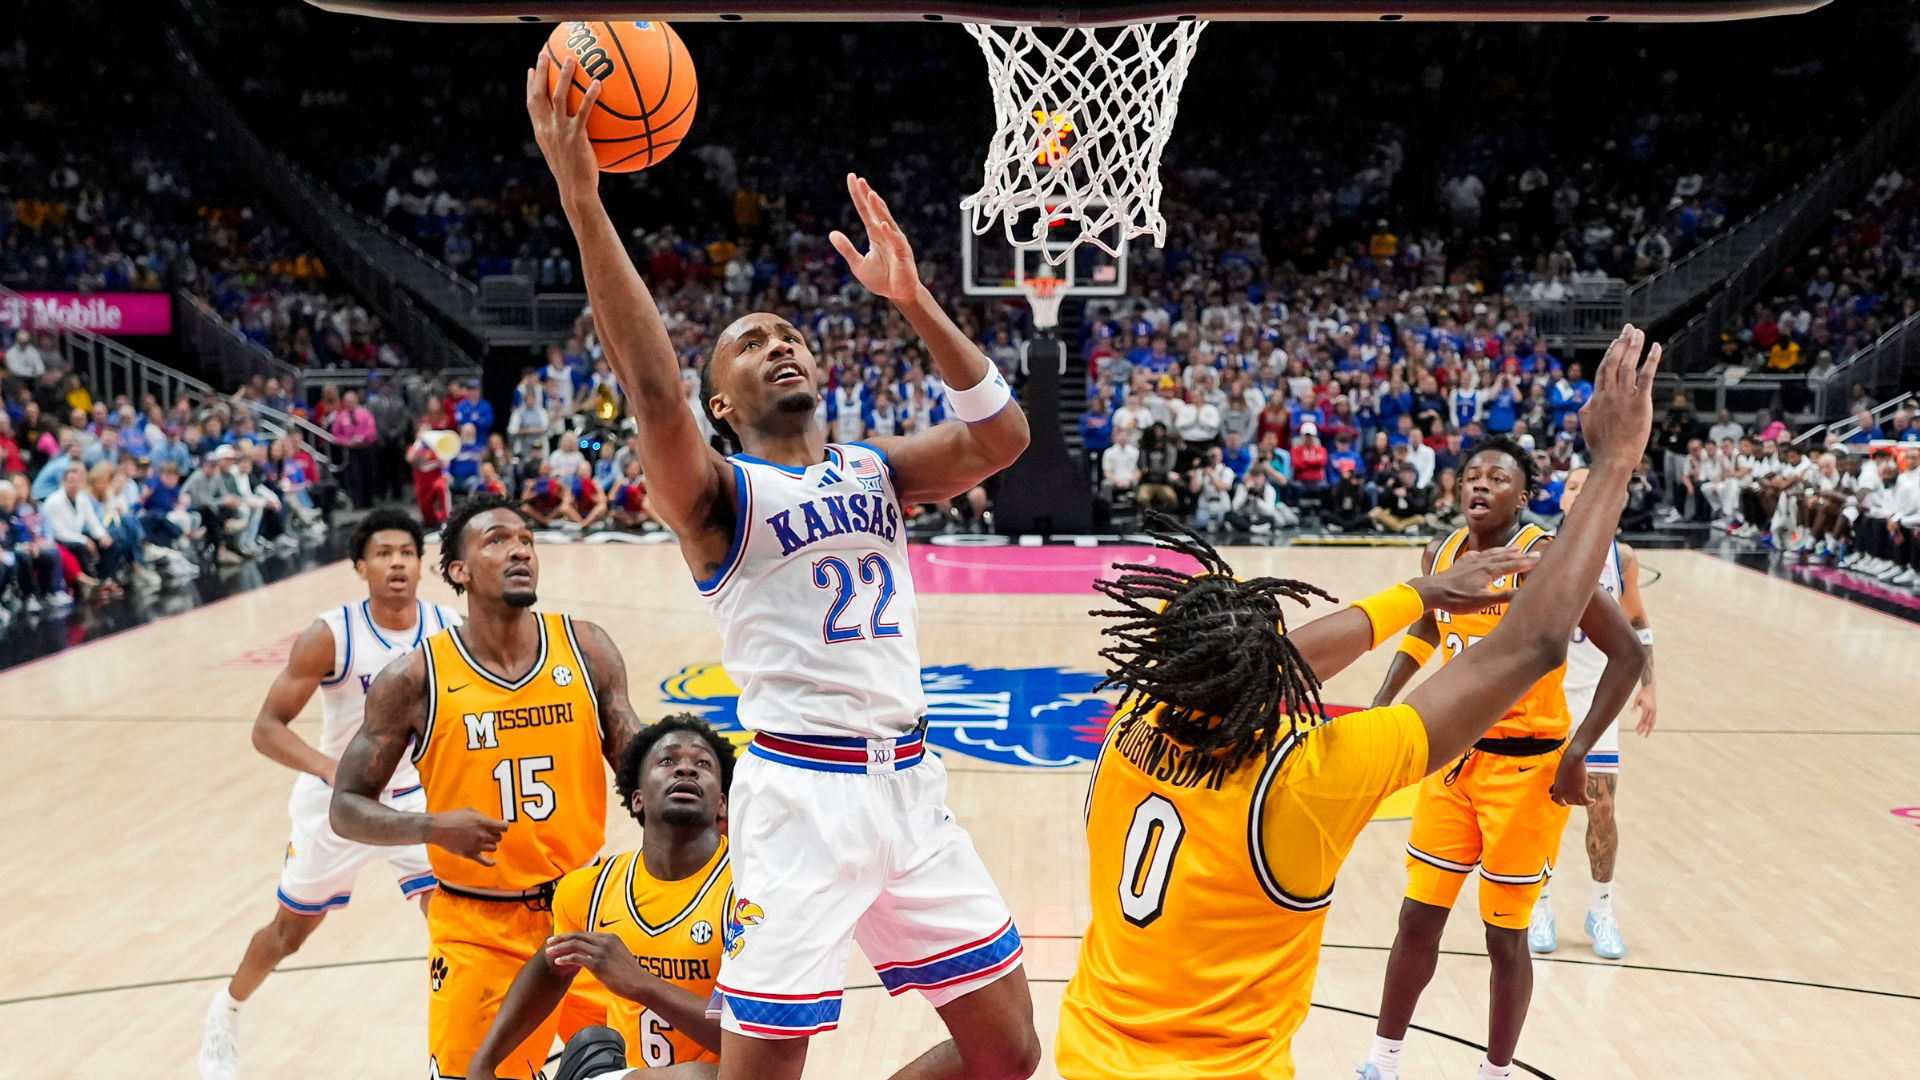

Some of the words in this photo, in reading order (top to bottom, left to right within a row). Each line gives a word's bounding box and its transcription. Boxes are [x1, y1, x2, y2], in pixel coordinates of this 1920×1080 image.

[766, 493, 899, 557] KANSAS
[811, 552, 903, 645] 22
[463, 703, 574, 750] MISSOURI
[493, 755, 556, 823] 15
[1118, 792, 1186, 929] 0
[691, 921, 712, 944] SEC
[634, 956, 711, 980] SSOURI
[639, 1007, 674, 1068] 6
